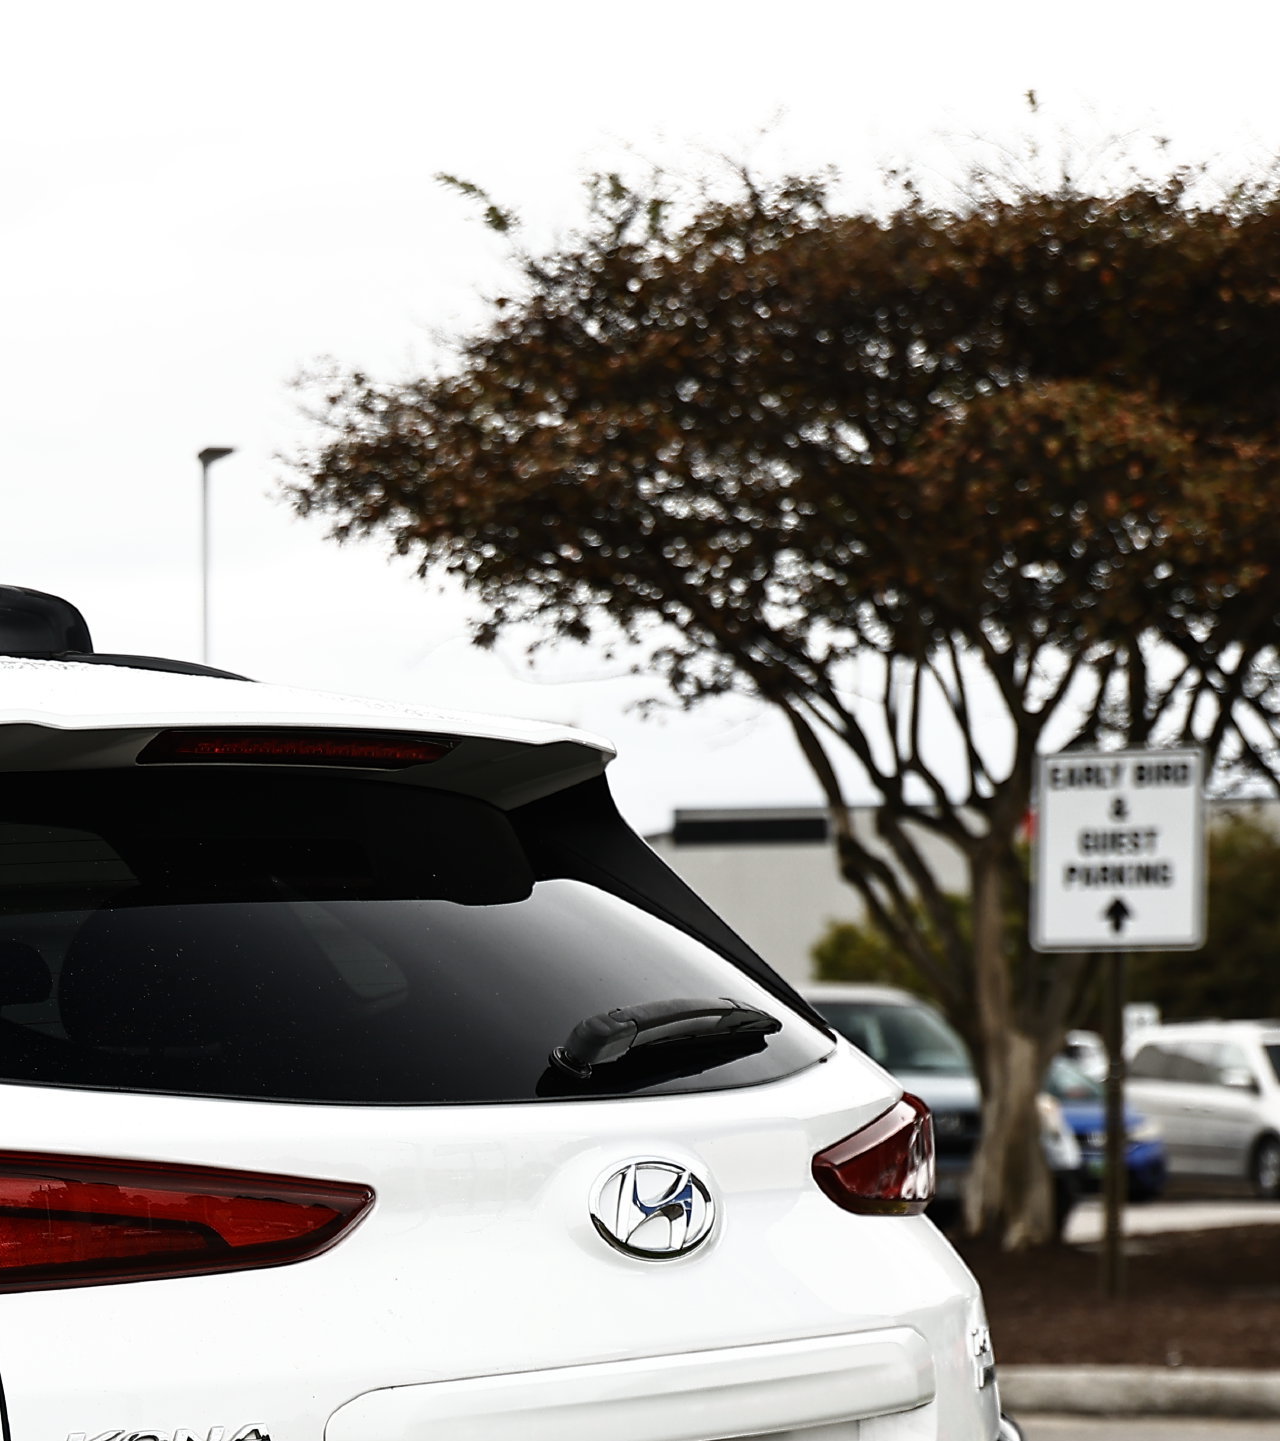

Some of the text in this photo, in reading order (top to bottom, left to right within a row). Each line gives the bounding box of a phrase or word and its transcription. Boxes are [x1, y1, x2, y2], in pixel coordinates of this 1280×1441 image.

[1050, 763, 1190, 789] EARLY BIRD
[1110, 797, 1128, 820] &
[1080, 829, 1158, 855] GUEST
[1065, 863, 1175, 889] PARKING
